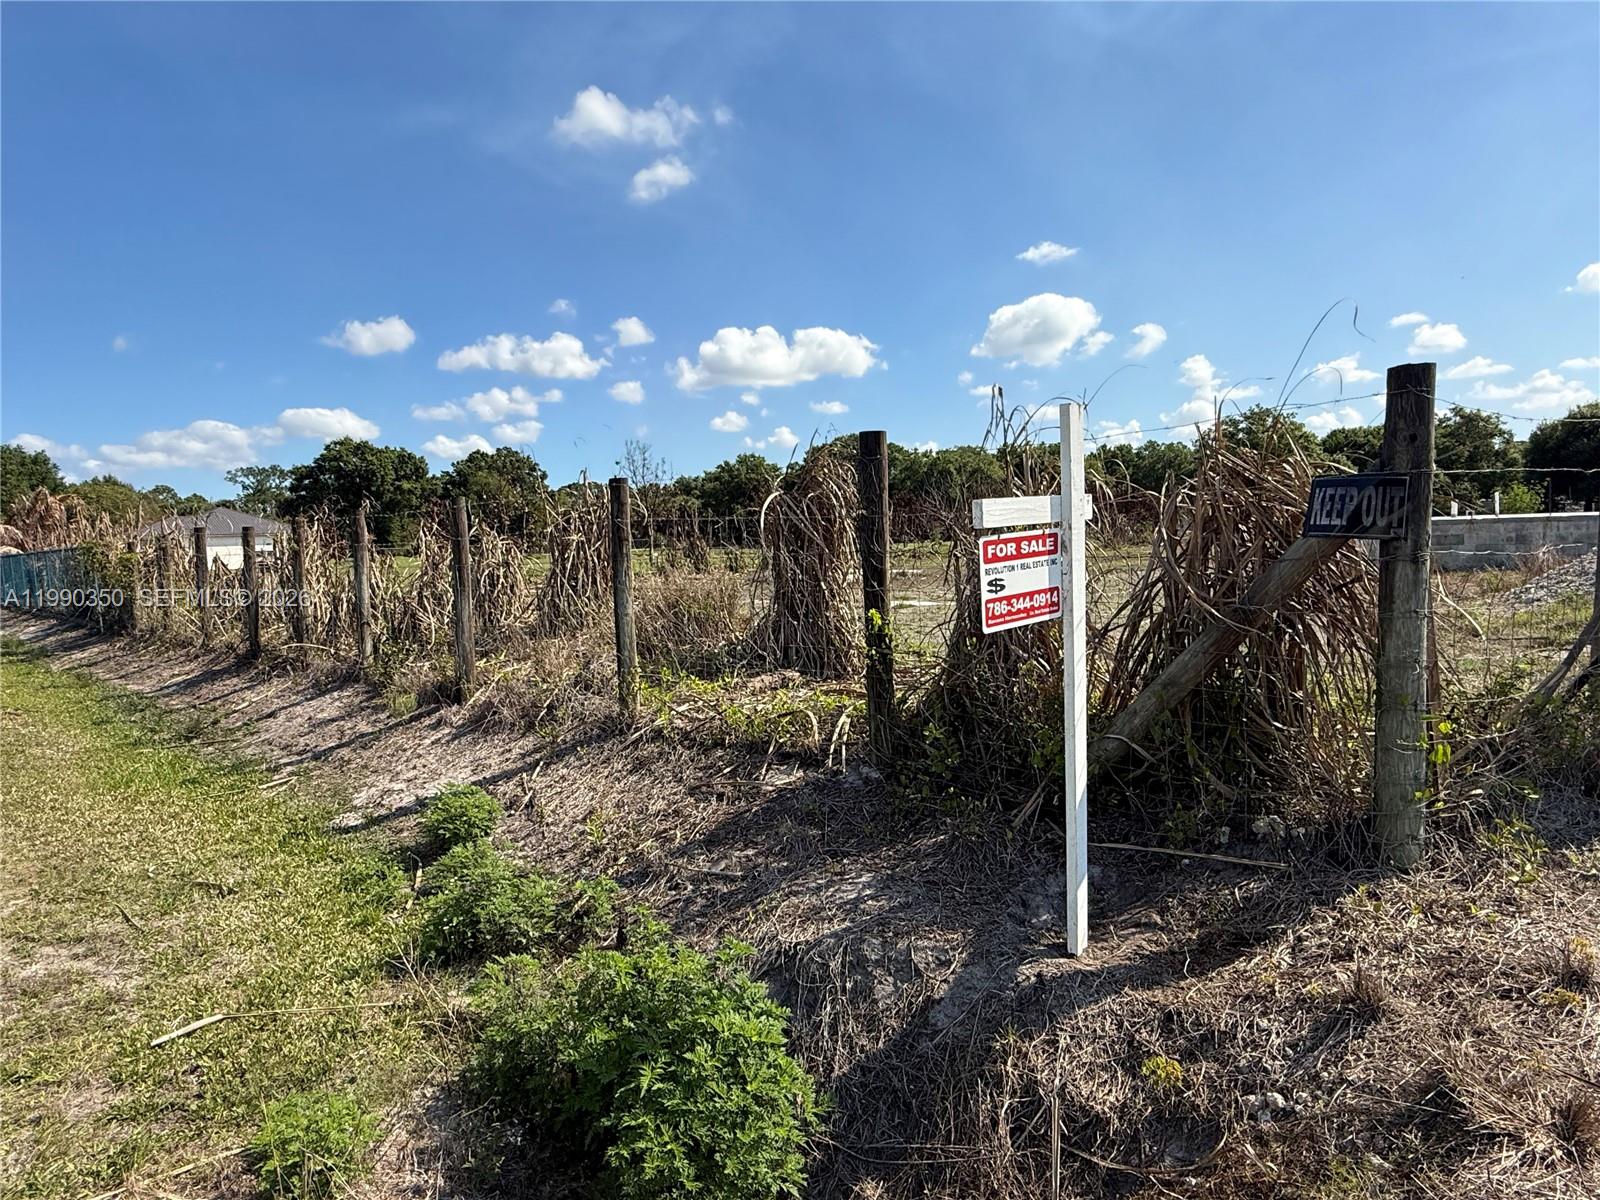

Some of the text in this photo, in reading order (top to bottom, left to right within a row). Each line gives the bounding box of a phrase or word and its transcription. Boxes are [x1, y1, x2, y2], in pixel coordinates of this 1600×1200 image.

[1310, 485, 1405, 527] KEEP OUT
[987, 537, 1055, 559] FOR SALE
[985, 565, 1016, 576] REVOLUTION
[1020, 560, 1032, 570] REAL
[1032, 558, 1050, 568] ESTATE
[987, 578, 1006, 594] $
[987, 590, 1058, 617] 786-344-0914
